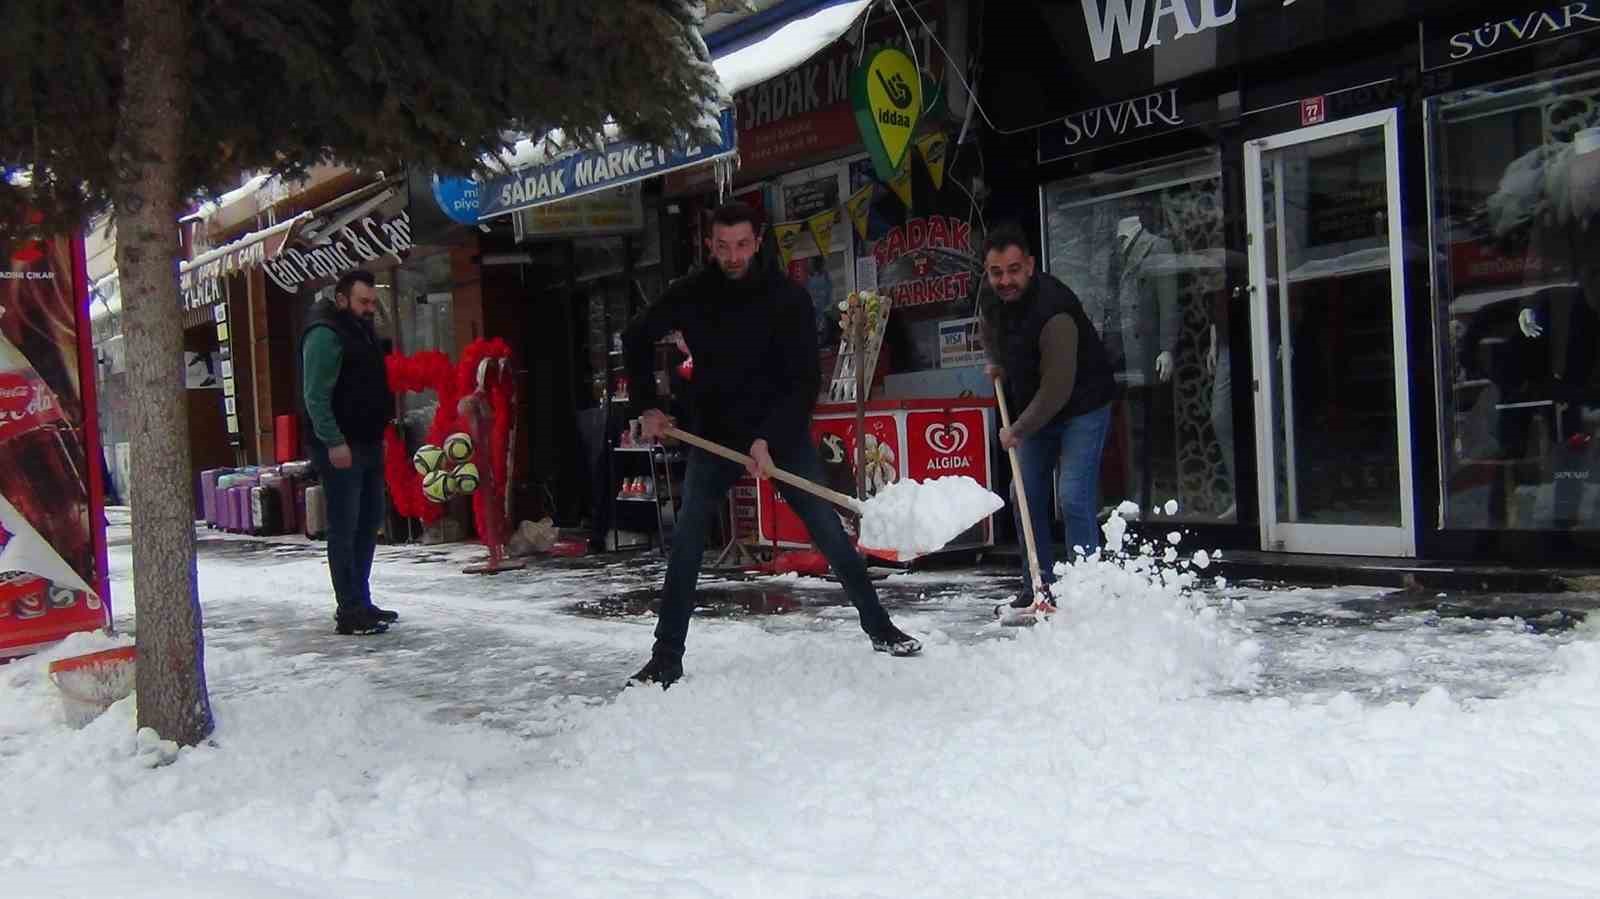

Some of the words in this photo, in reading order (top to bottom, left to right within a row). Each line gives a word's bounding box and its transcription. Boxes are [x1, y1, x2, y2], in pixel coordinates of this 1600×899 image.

[501, 169, 565, 206] SADAK
[575, 142, 666, 188] MARKET
[341, 222, 380, 261] &
[886, 271, 972, 309] ARKET
[927, 455, 970, 470] ALGIDA
